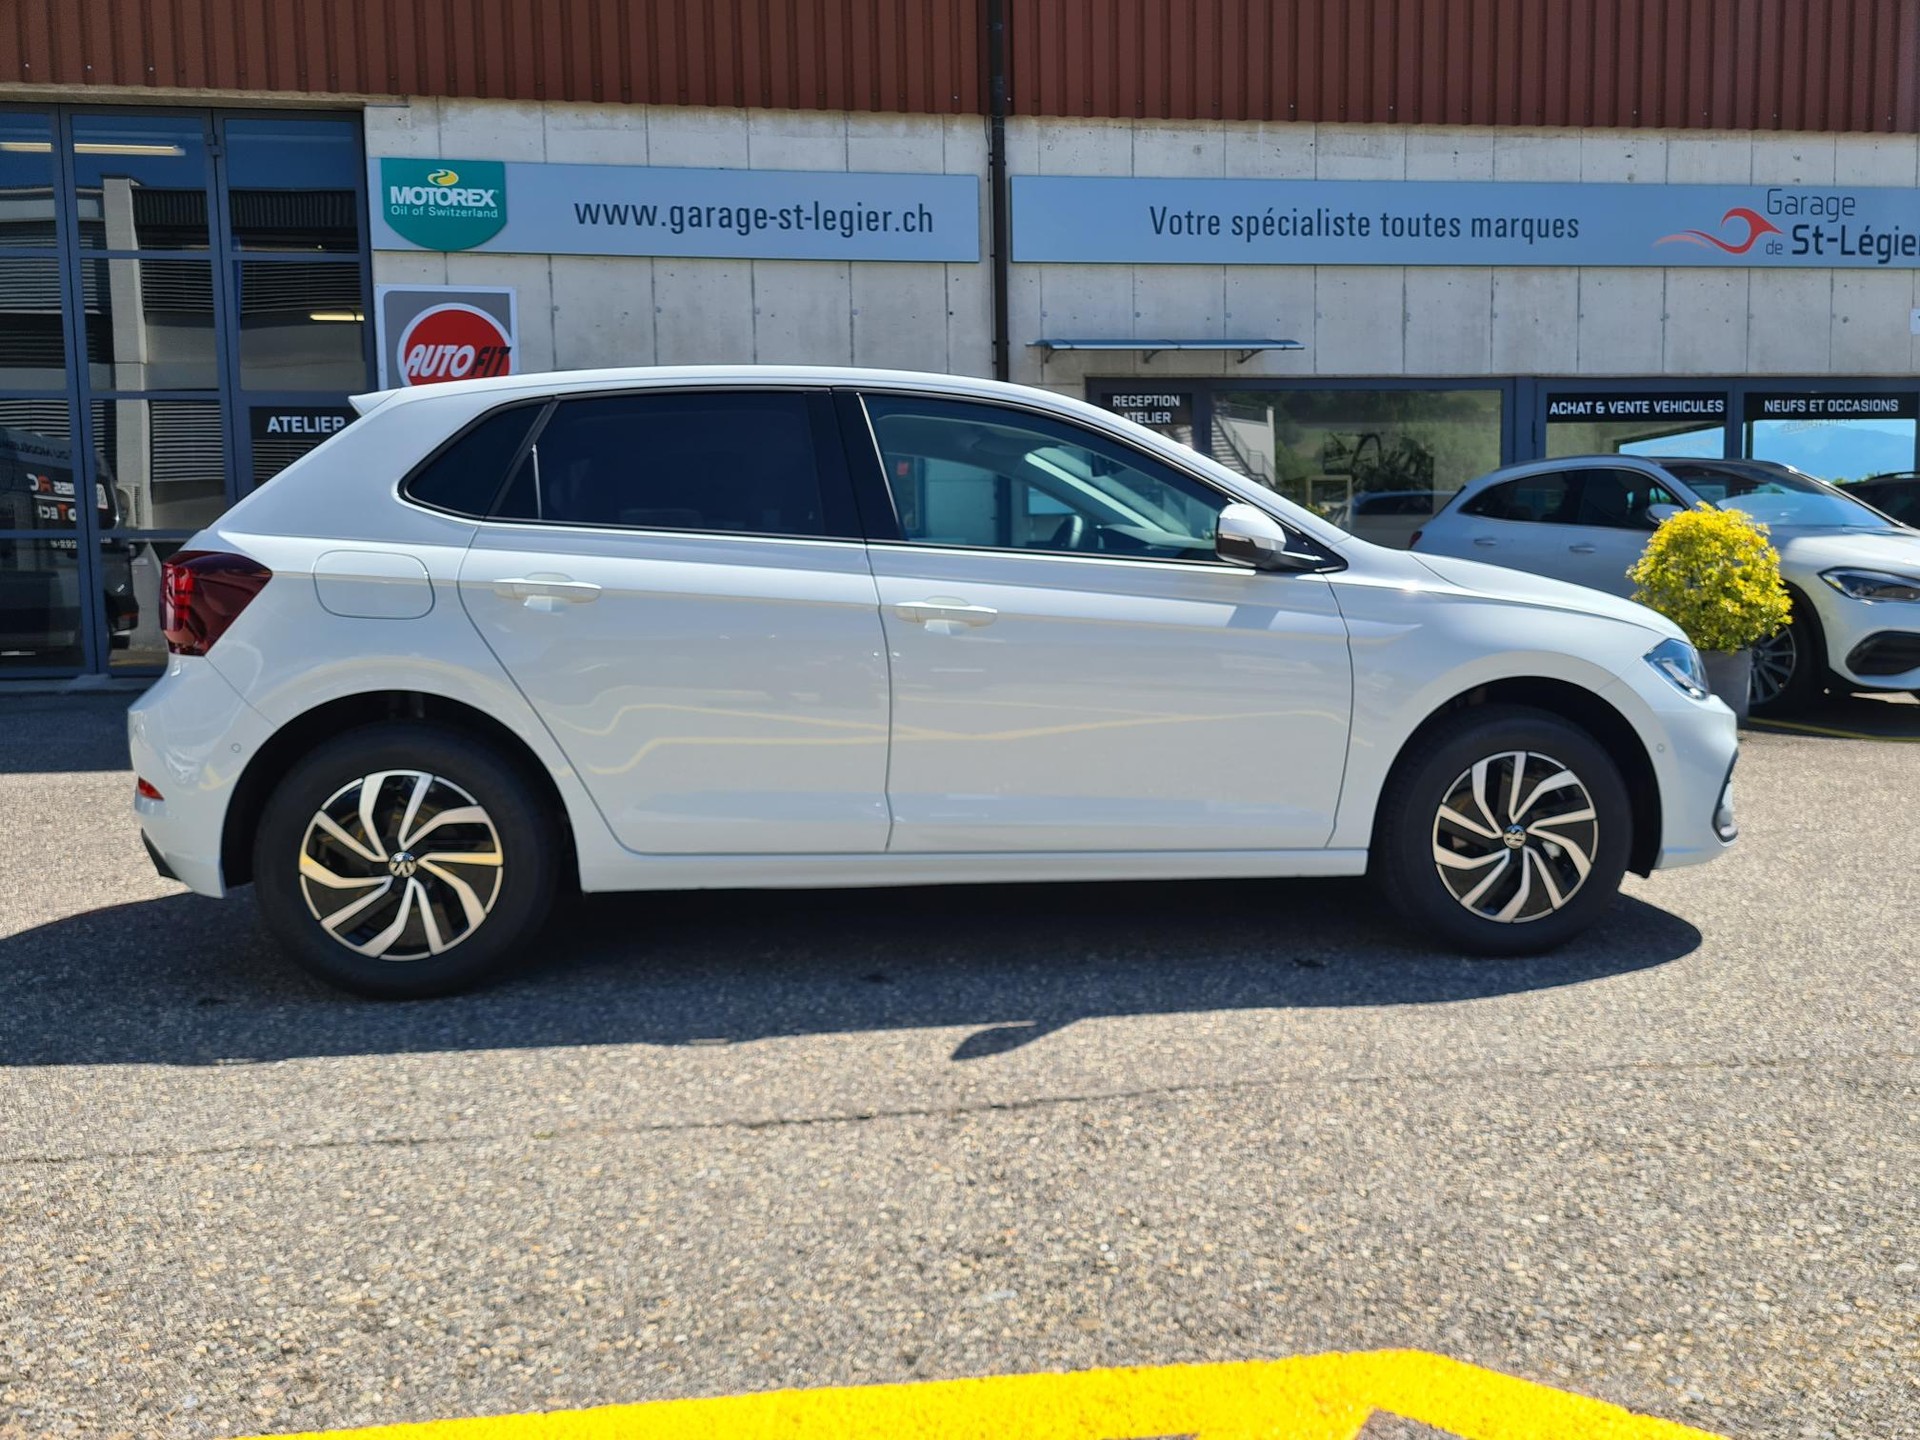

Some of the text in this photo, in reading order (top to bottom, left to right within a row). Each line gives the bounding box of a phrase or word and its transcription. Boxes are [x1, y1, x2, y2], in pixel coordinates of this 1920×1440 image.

[390, 186, 497, 207] MOTOREX
[1766, 188, 1856, 223] Garage
[391, 205, 498, 218] Oil of Switzerland
[574, 201, 934, 238] www.garage-st-legier.ch
[1150, 206, 1579, 244] Votre spécialiste toutes marques
[1765, 224, 1920, 264] de St-Légie
[405, 344, 512, 377] AUTOFIT
[1112, 395, 1180, 407] RECEPTION
[1549, 400, 1724, 415] ACHAT & VENTE VEHICULES
[1764, 400, 1899, 413] NEUFS ET OCCASIONS
